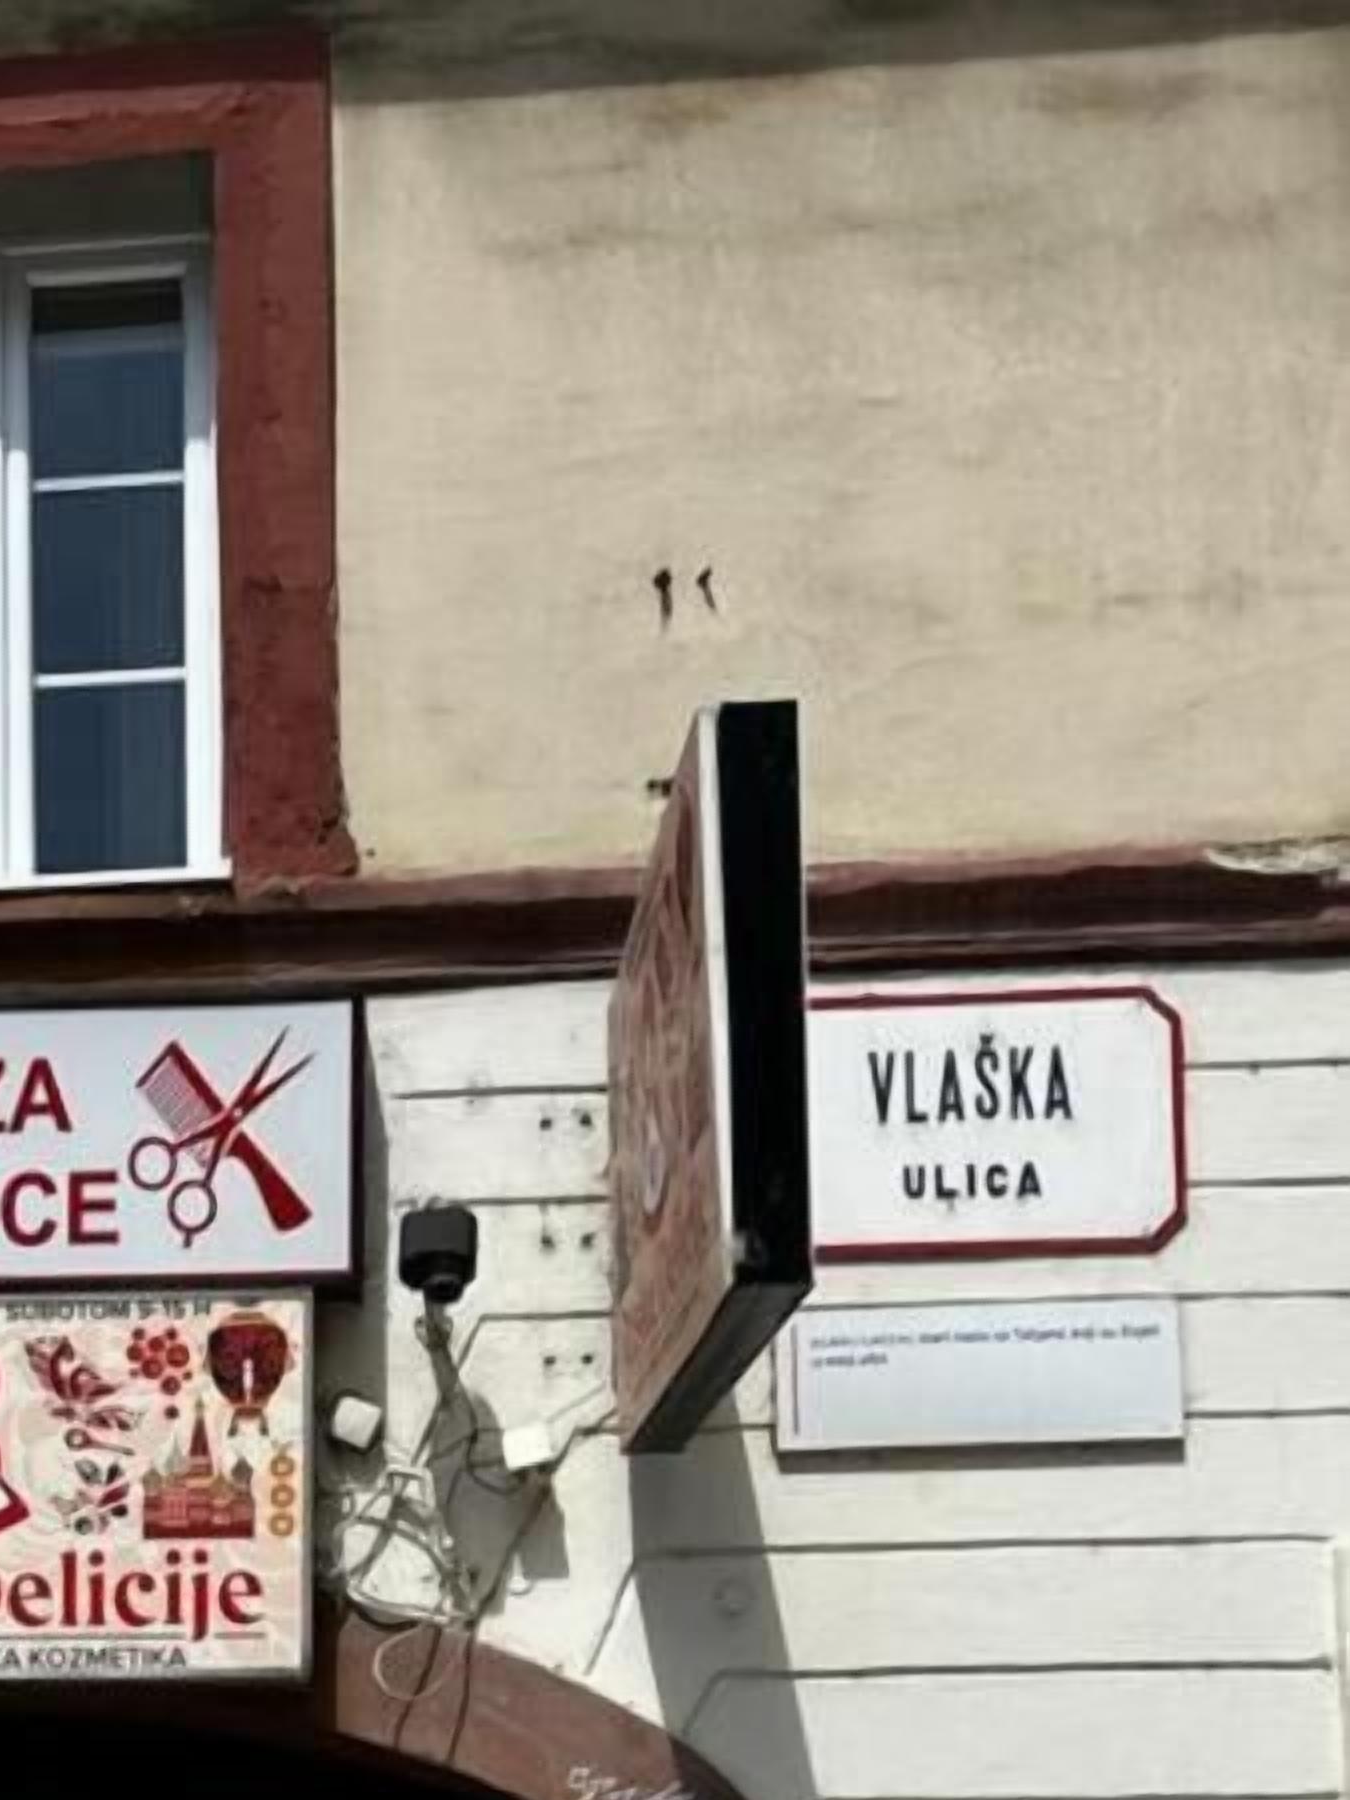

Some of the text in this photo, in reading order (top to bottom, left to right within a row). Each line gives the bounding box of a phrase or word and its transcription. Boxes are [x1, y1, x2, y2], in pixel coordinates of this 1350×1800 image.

[868, 1034, 1074, 1126] VLAŠKA
[902, 1161, 1043, 1199] ULICA
[28, 1646, 187, 1669] KOZMETIKA
